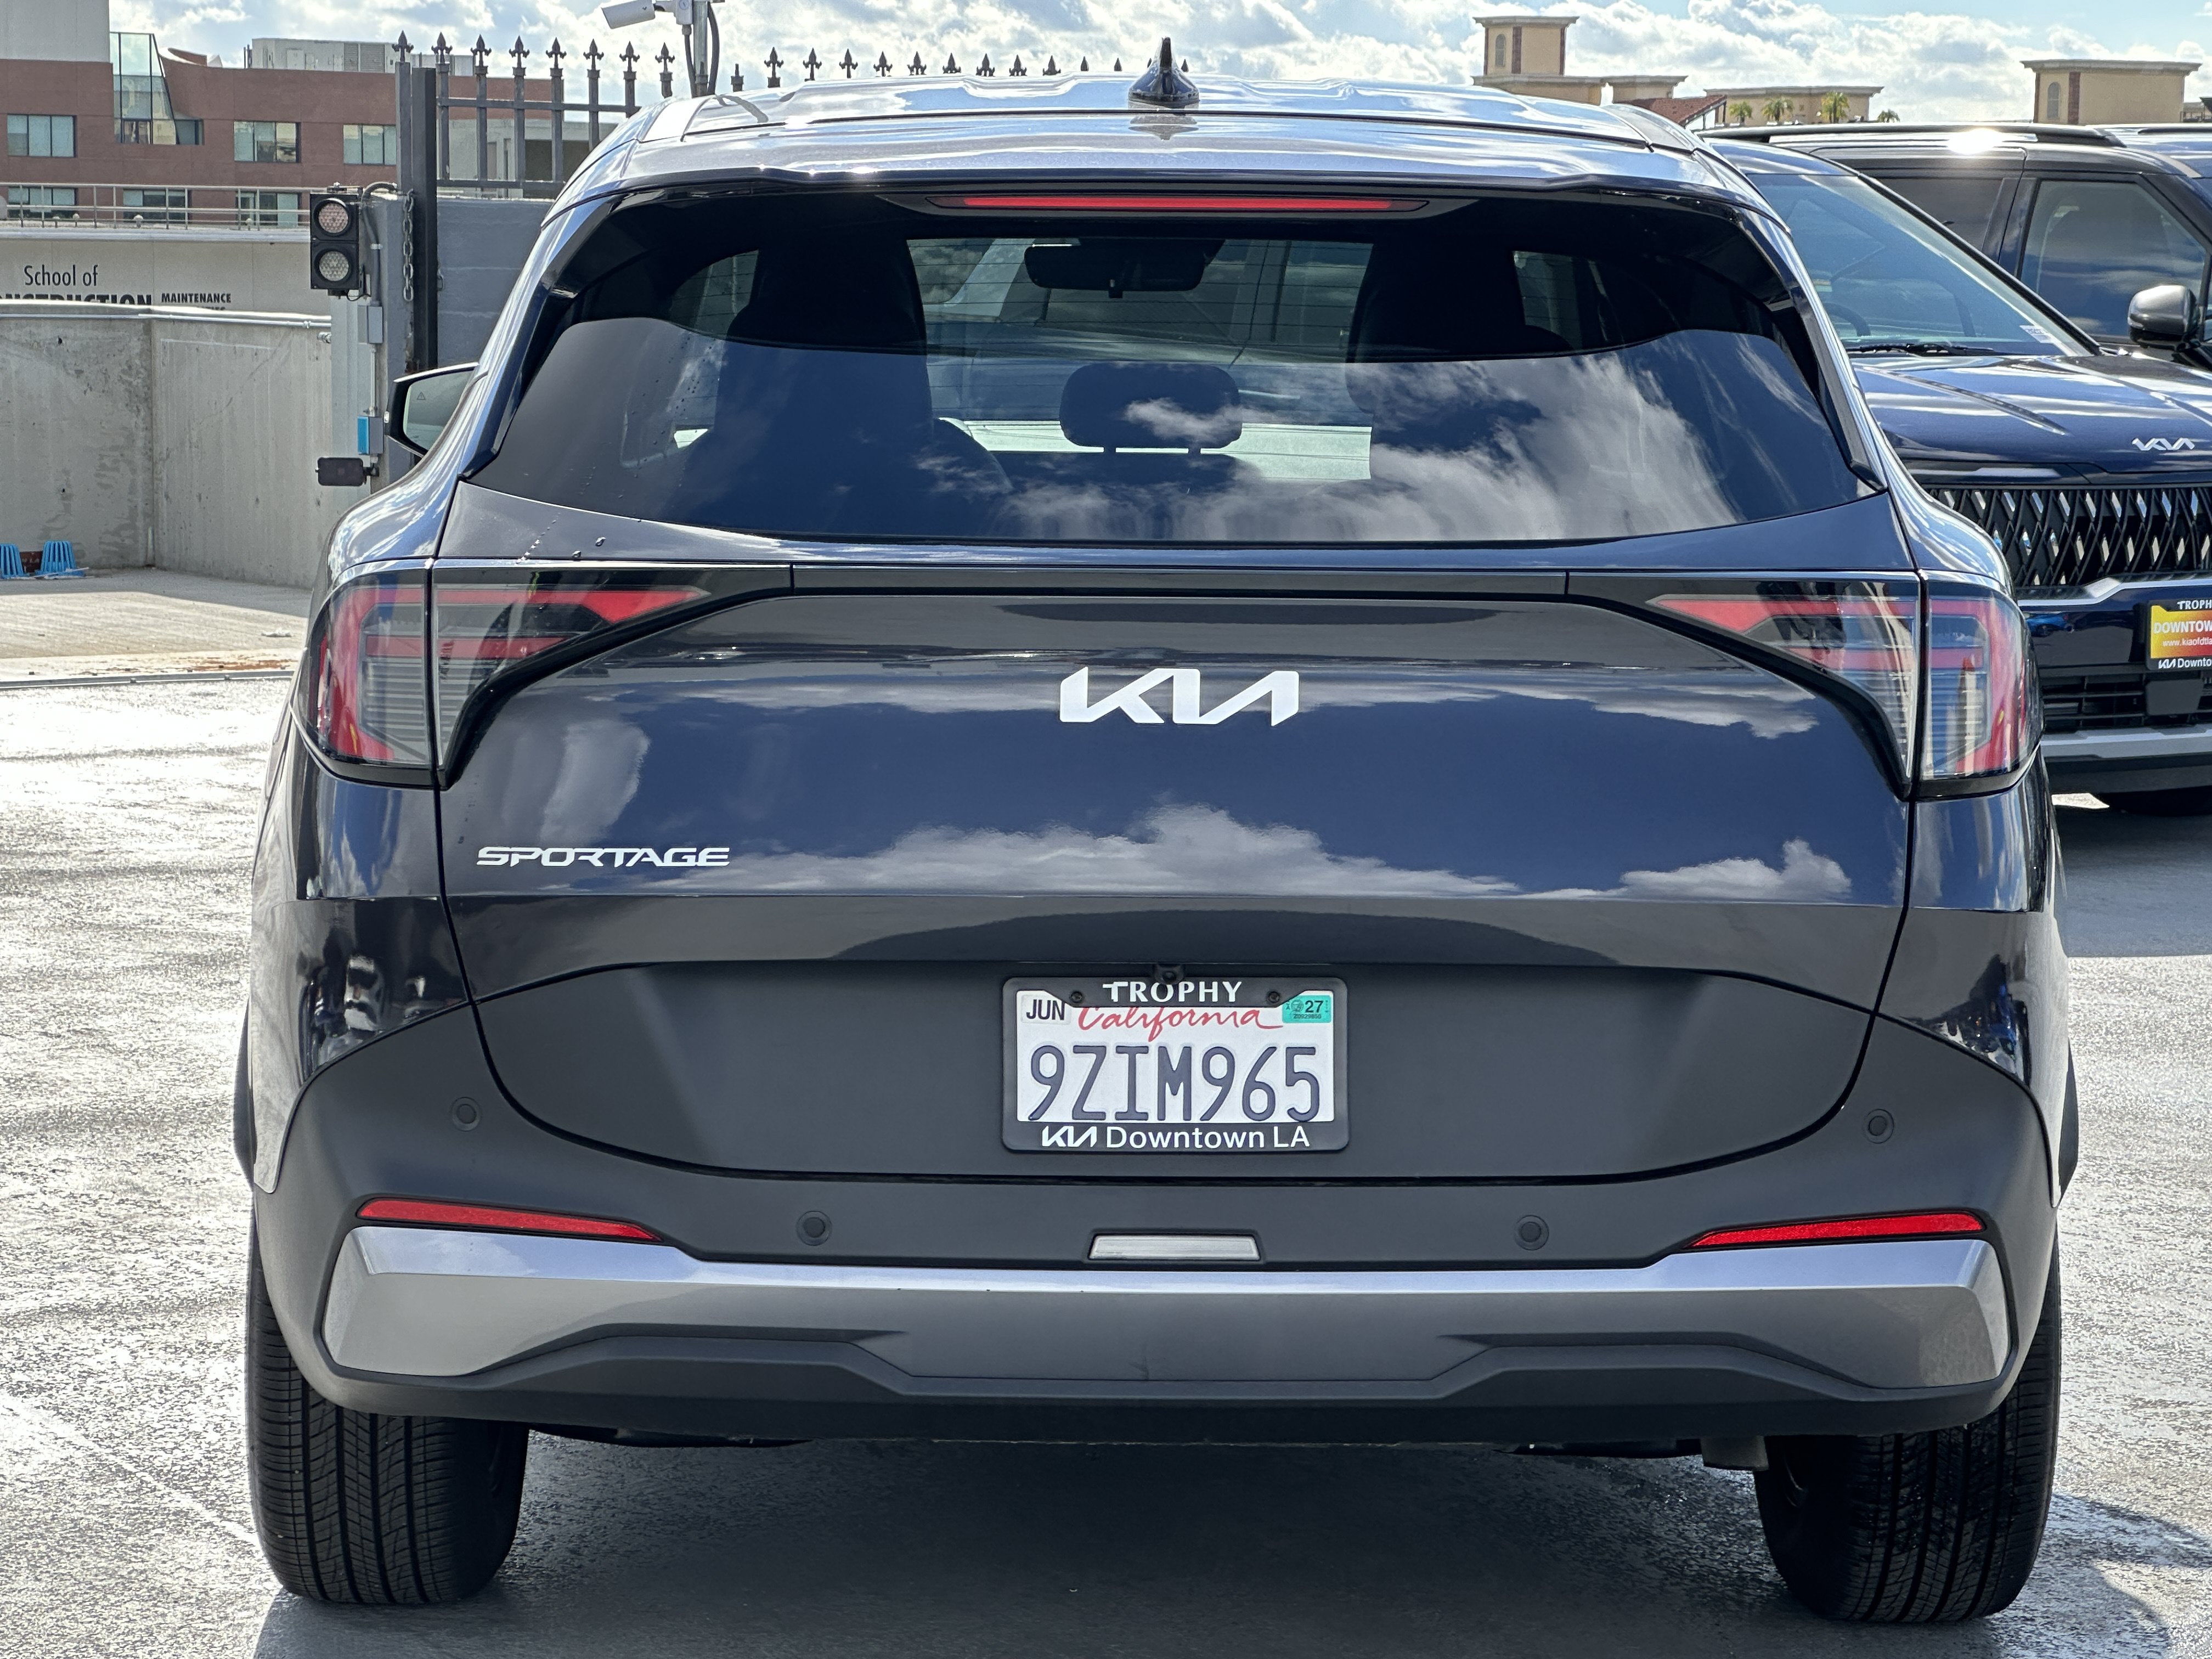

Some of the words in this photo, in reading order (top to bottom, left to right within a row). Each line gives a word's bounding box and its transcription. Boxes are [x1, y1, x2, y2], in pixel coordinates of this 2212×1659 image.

[24, 264, 76, 286] School
[82, 264, 98, 286] of
[161, 293, 232, 303] MAINTENANCE
[1060, 666, 1300, 726] KIA
[477, 847, 730, 867] SPORTAGE
[1103, 981, 1242, 1002] TROPHY
[1026, 999, 1065, 1020] JUN
[1305, 1000, 1324, 1013] 27
[1078, 1007, 1283, 1042] California
[1028, 1045, 1320, 1121] 9ZIM965
[1042, 1126, 1097, 1148] KIA
[1107, 1126, 1265, 1149] Downtown
[1274, 1126, 1310, 1148] LA
